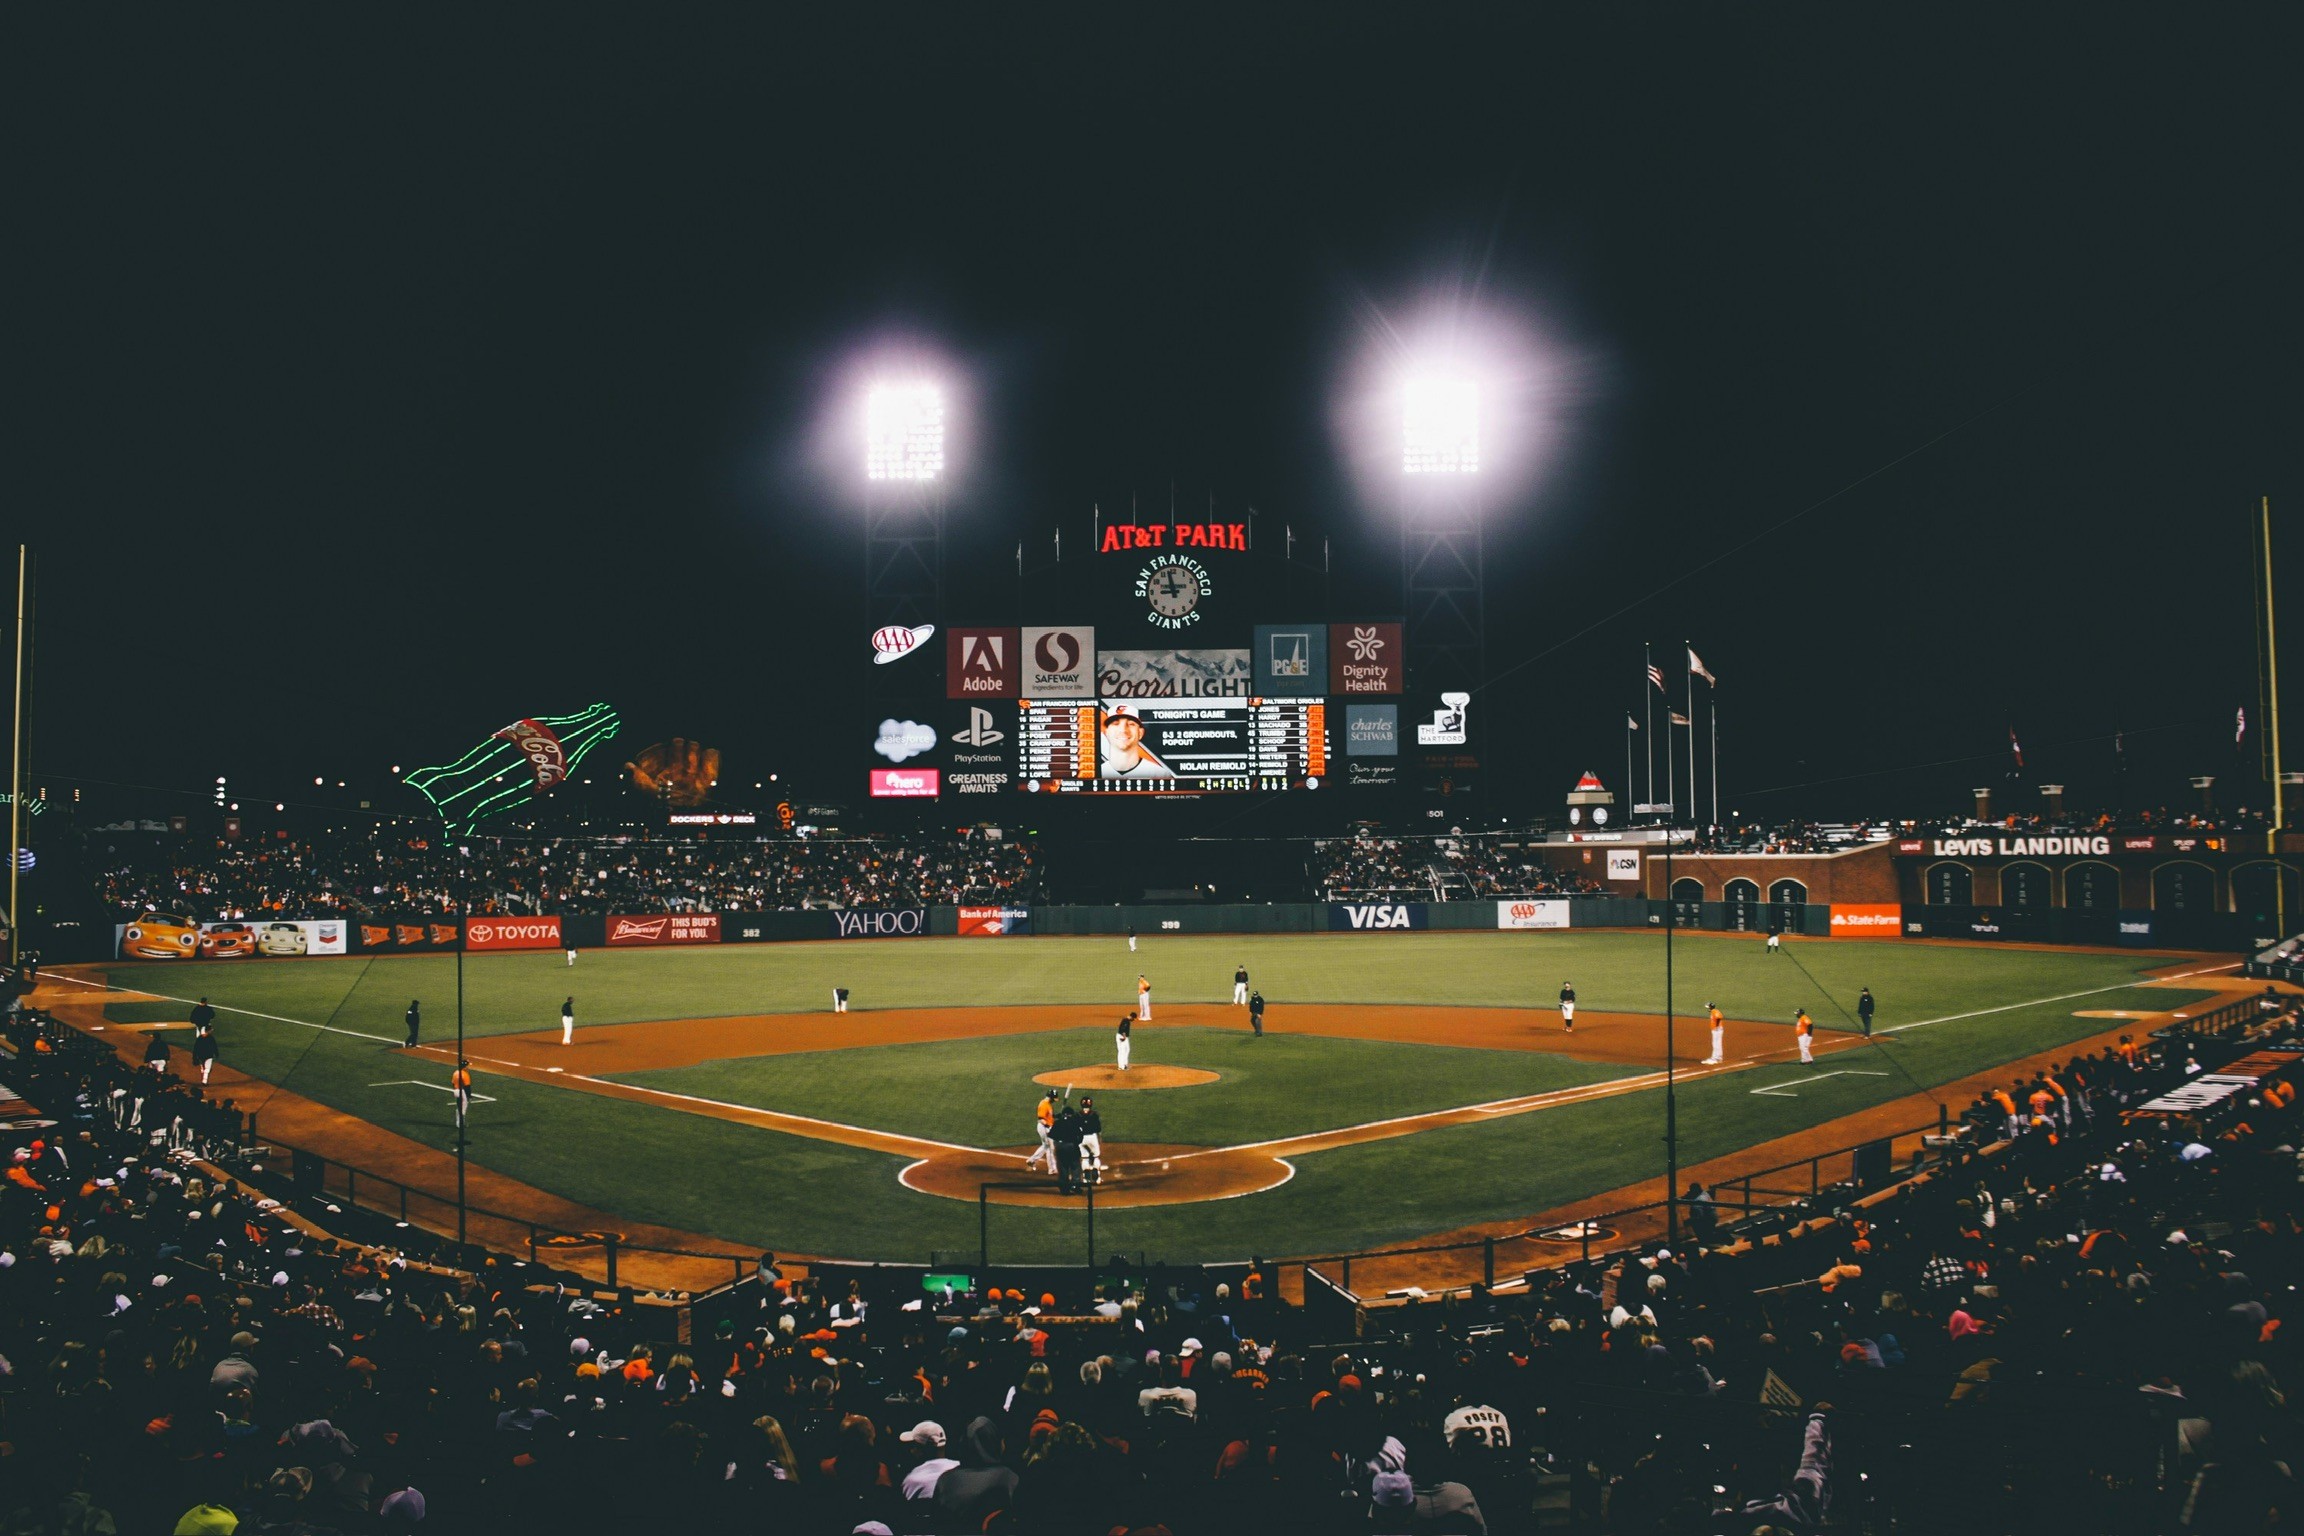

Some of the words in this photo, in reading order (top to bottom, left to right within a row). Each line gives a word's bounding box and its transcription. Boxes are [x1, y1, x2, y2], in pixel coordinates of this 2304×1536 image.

[1101, 525, 1167, 552] AT&T
[1175, 524, 1246, 551] PARK
[1136, 568, 1151, 597] SAN
[1150, 554, 1211, 596] FRANCISCO
[1148, 611, 1200, 629] GIANTS
[876, 628, 912, 652] AAA
[1274, 660, 1306, 675] PG&E
[1344, 665, 1388, 678] Dignity
[963, 677, 1003, 691] Adobe
[1035, 675, 1079, 683] SAFEWAY
[1100, 670, 1178, 697] Coors
[1181, 678, 1250, 696] LIGHT
[1346, 680, 1386, 691] Health
[1153, 711, 1198, 719] TONIGHT'S
[1351, 718, 1392, 730] charles
[882, 735, 930, 745] salesforce
[1183, 731, 1237, 739] GROUNDOUTS,
[1351, 732, 1393, 740] SCHWAB
[522, 738, 564, 788] Cola
[955, 755, 1001, 764] PlayStation
[1180, 763, 1208, 771] NOLAN
[1210, 762, 1246, 770] REIMOLD
[1349, 763, 1370, 773] Own
[1372, 767, 1395, 777] your
[949, 774, 1007, 784] GREATNESS
[959, 784, 998, 793] AWAITS
[808, 808, 839, 816] @SFGiants
[1999, 837, 2110, 855] LANDING
[1620, 859, 1637, 868] CSN
[960, 910, 982, 918] Bank
[983, 910, 991, 918] of
[992, 910, 1027, 918] America
[1343, 906, 1410, 928] VISA
[1511, 904, 1535, 919] AAA
[672, 918, 690, 927] THIS
[692, 917, 717, 927] BUD'S
[835, 910, 924, 936] YAHOO!
[1161, 921, 1180, 929] 399
[1847, 915, 1873, 925] State
[1874, 915, 1900, 925] Farm
[496, 925, 559, 939] TOYOTA
[619, 924, 661, 935] Budweiser
[672, 929, 687, 939] FOR
[690, 929, 708, 938] YOU.
[743, 929, 760, 938] 382
[1464, 1413, 1500, 1425] POSEY
